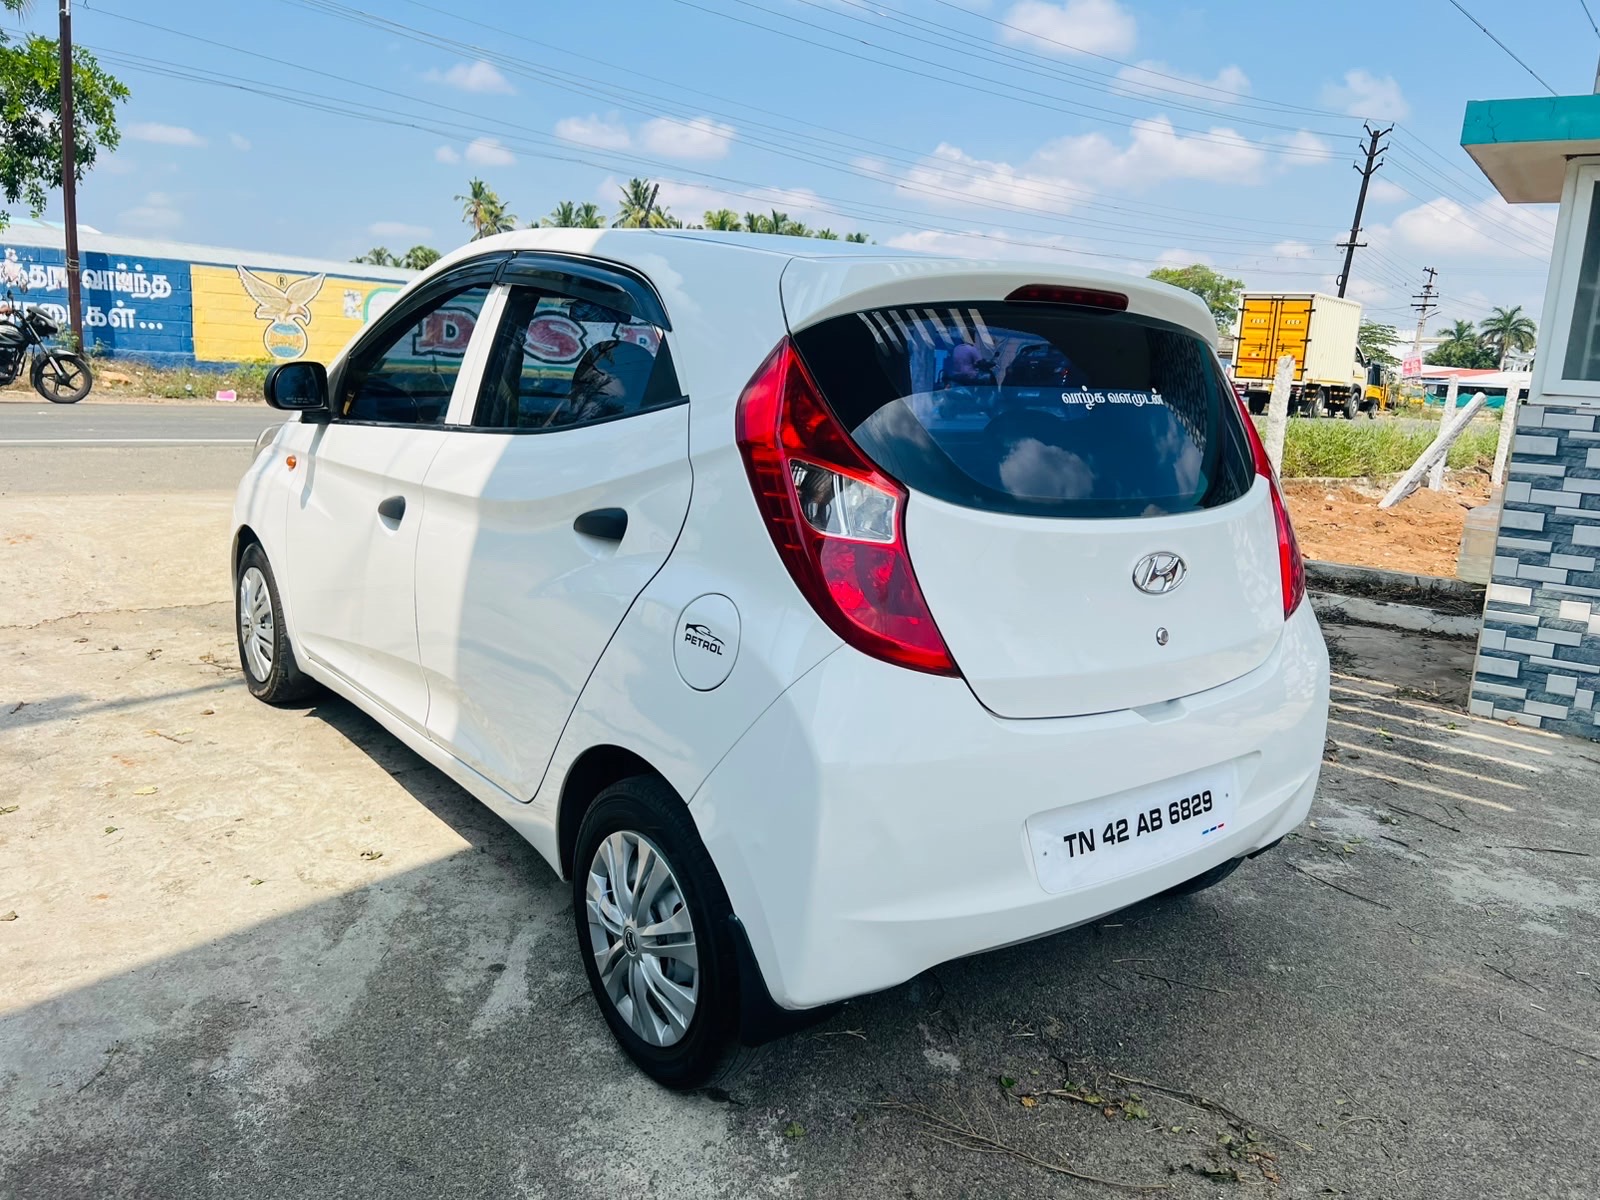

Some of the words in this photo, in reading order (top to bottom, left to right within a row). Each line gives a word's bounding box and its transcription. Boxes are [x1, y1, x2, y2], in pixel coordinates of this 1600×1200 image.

[81, 263, 172, 300] வாய்ந்த
[1061, 385, 1106, 411] வாழ்க
[1107, 387, 1164, 408] வளமுடன்
[684, 632, 723, 656] PETROL
[1063, 828, 1096, 858] TN
[1102, 818, 1130, 846] 42
[1136, 807, 1163, 837] AB
[1168, 790, 1213, 825] 6829
